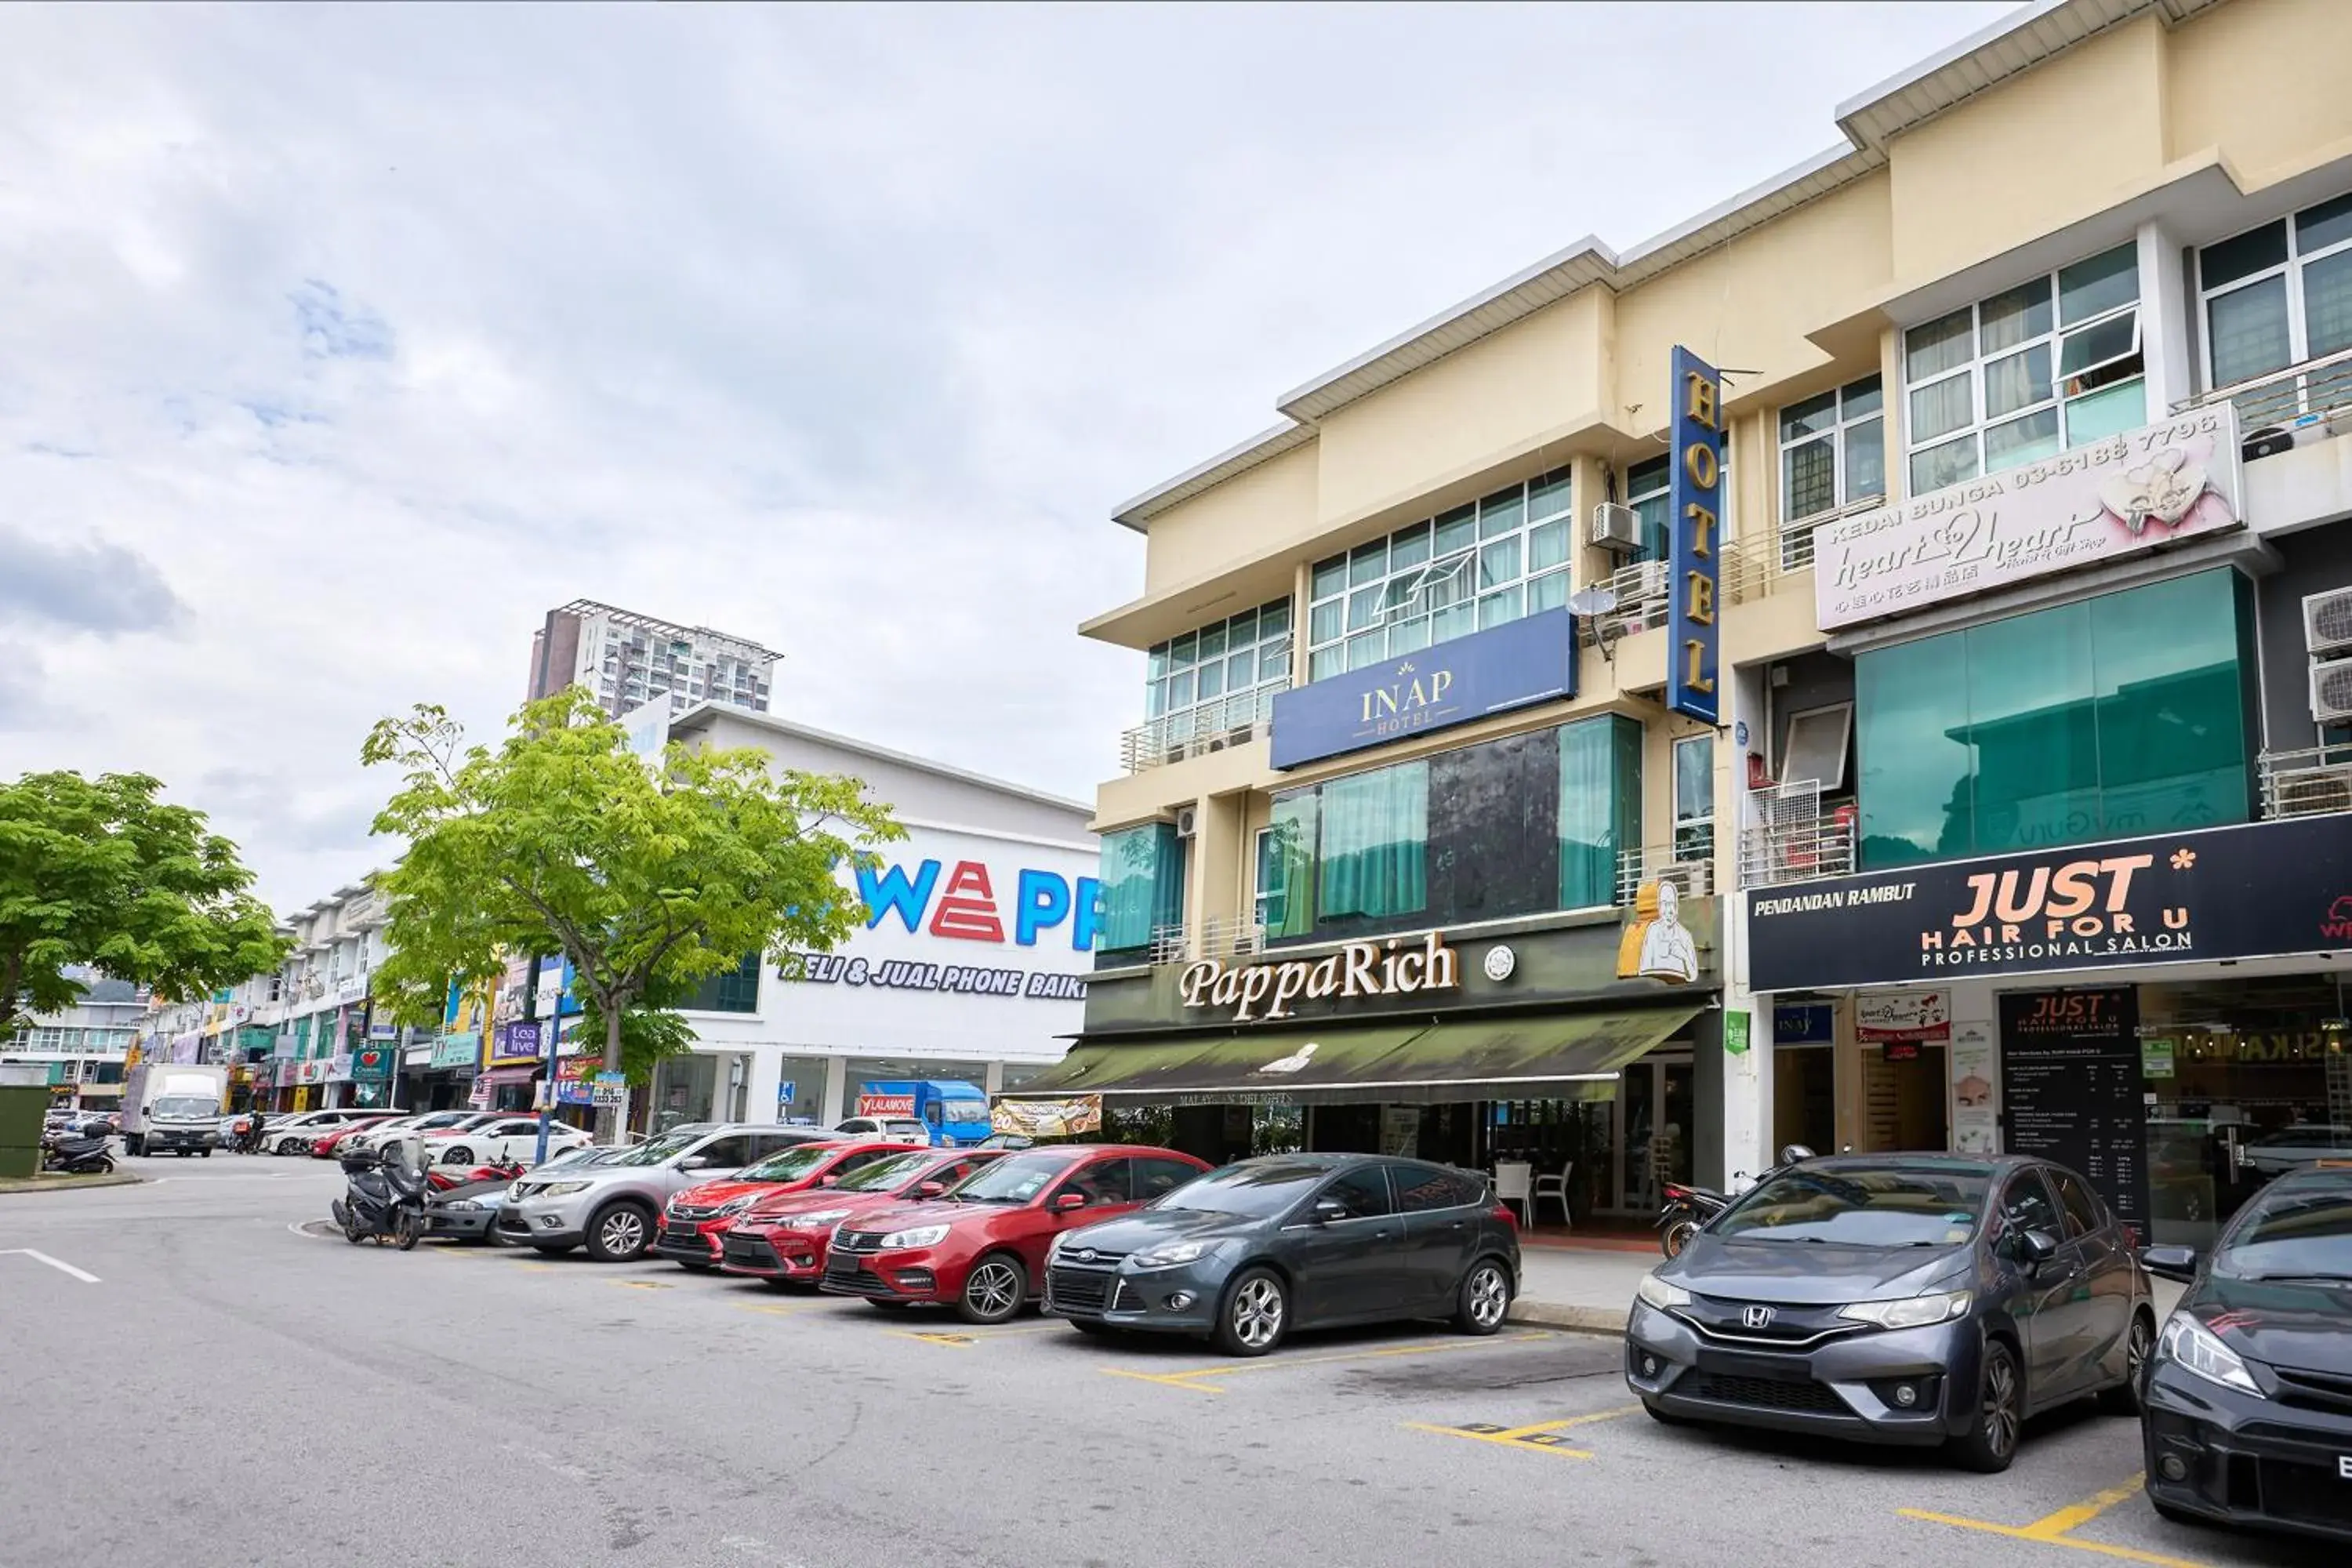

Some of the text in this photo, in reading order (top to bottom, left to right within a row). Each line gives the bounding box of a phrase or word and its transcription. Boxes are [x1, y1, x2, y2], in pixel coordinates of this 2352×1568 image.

[1686, 370, 1717, 694] HOTEL
[1830, 513, 1903, 545] KEDAI
[1910, 480, 2005, 519] BUNGA
[1361, 670, 1453, 722] INAP
[1377, 710, 1434, 735] HOTEL
[786, 848, 1106, 951] WAPP
[1755, 882, 1915, 916] PENDANDAN RAMBUT
[1951, 854, 2154, 927] JUST
[1922, 907, 2189, 951] HAIR FOR U
[1922, 941, 2092, 966] PROFESSIONAL
[2107, 931, 2193, 953] SALON
[844, 956, 869, 986] &
[872, 960, 938, 989] JUAL
[939, 966, 1023, 995] PHONE
[1179, 931, 1460, 1021] PappaRich
[2032, 994, 2105, 1018] JUST
[510, 1040, 535, 1052] live
[512, 1026, 536, 1040] tea
[870, 1098, 915, 1111] LALAMOVE
